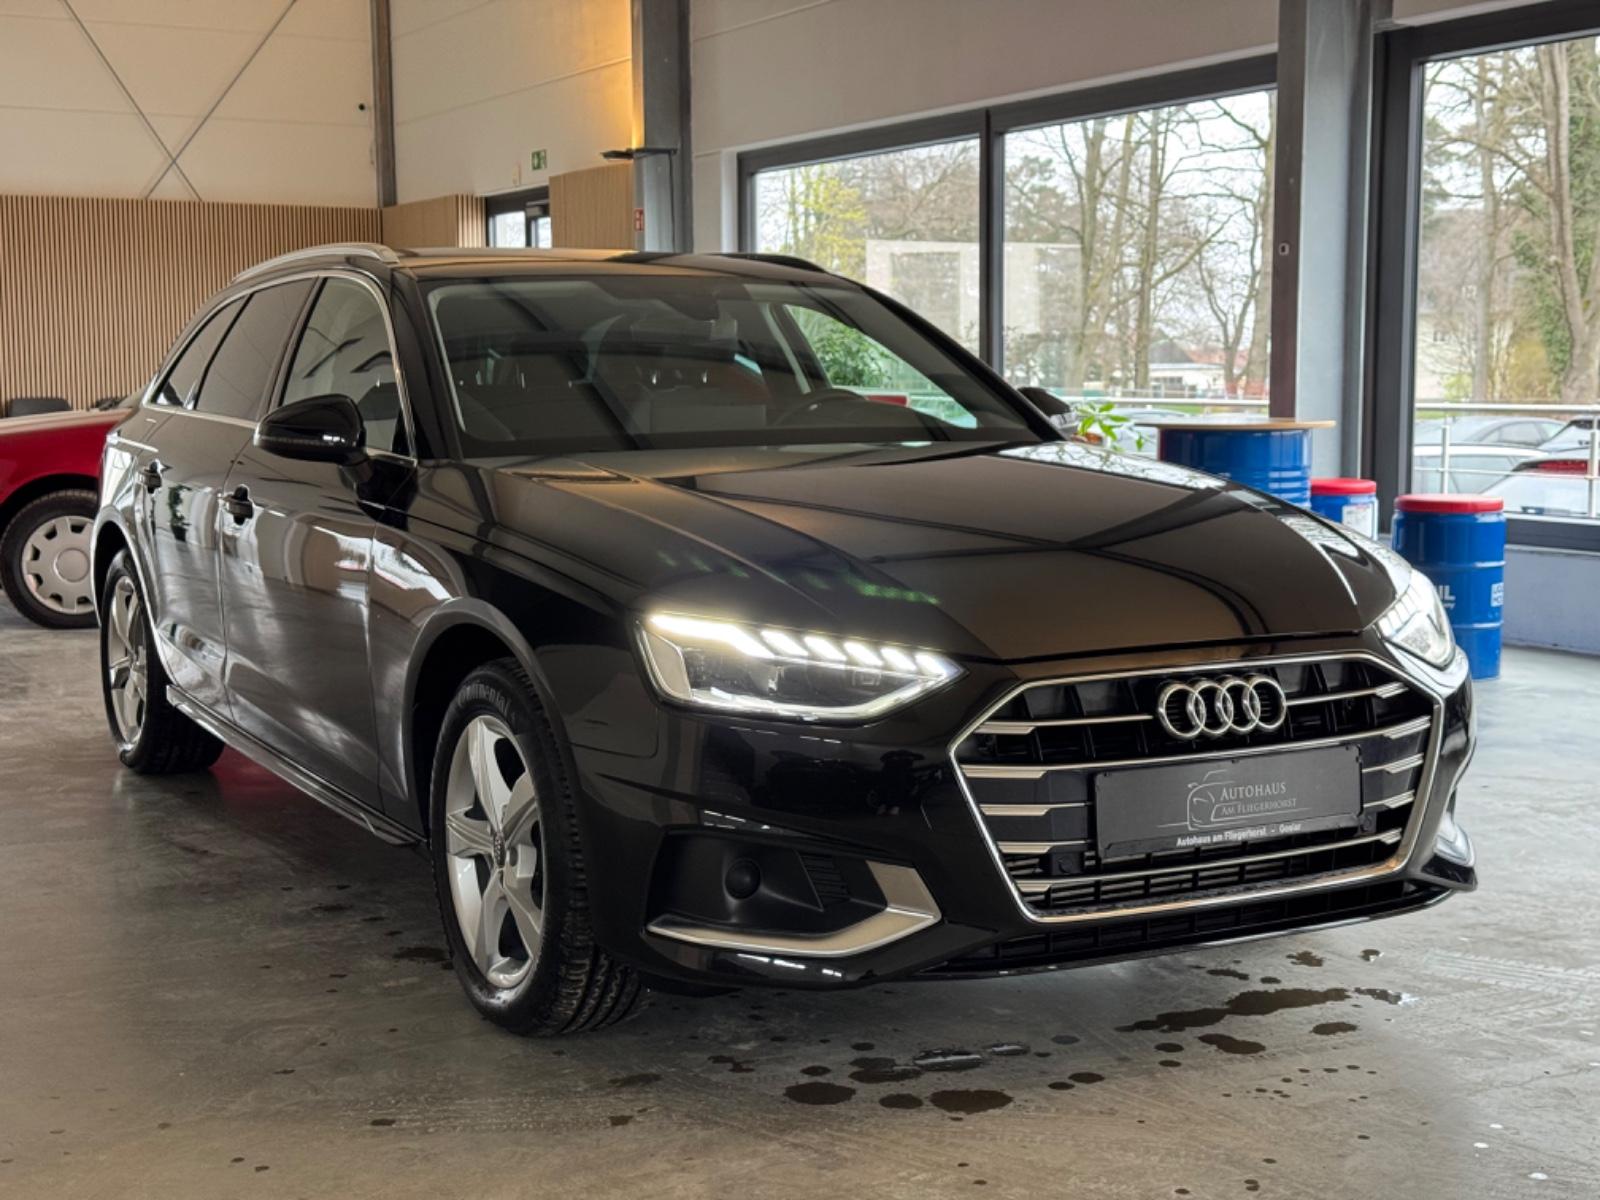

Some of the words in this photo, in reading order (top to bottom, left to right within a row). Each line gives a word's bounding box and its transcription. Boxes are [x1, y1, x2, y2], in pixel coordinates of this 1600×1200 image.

[1220, 781, 1286, 801] AUTOHAUS
[1237, 798, 1297, 813] FLIEGERHORST
[1176, 835, 1211, 847] Autohaus
[1212, 834, 1223, 842] am
[1223, 826, 1267, 841] Fliegerhorst
